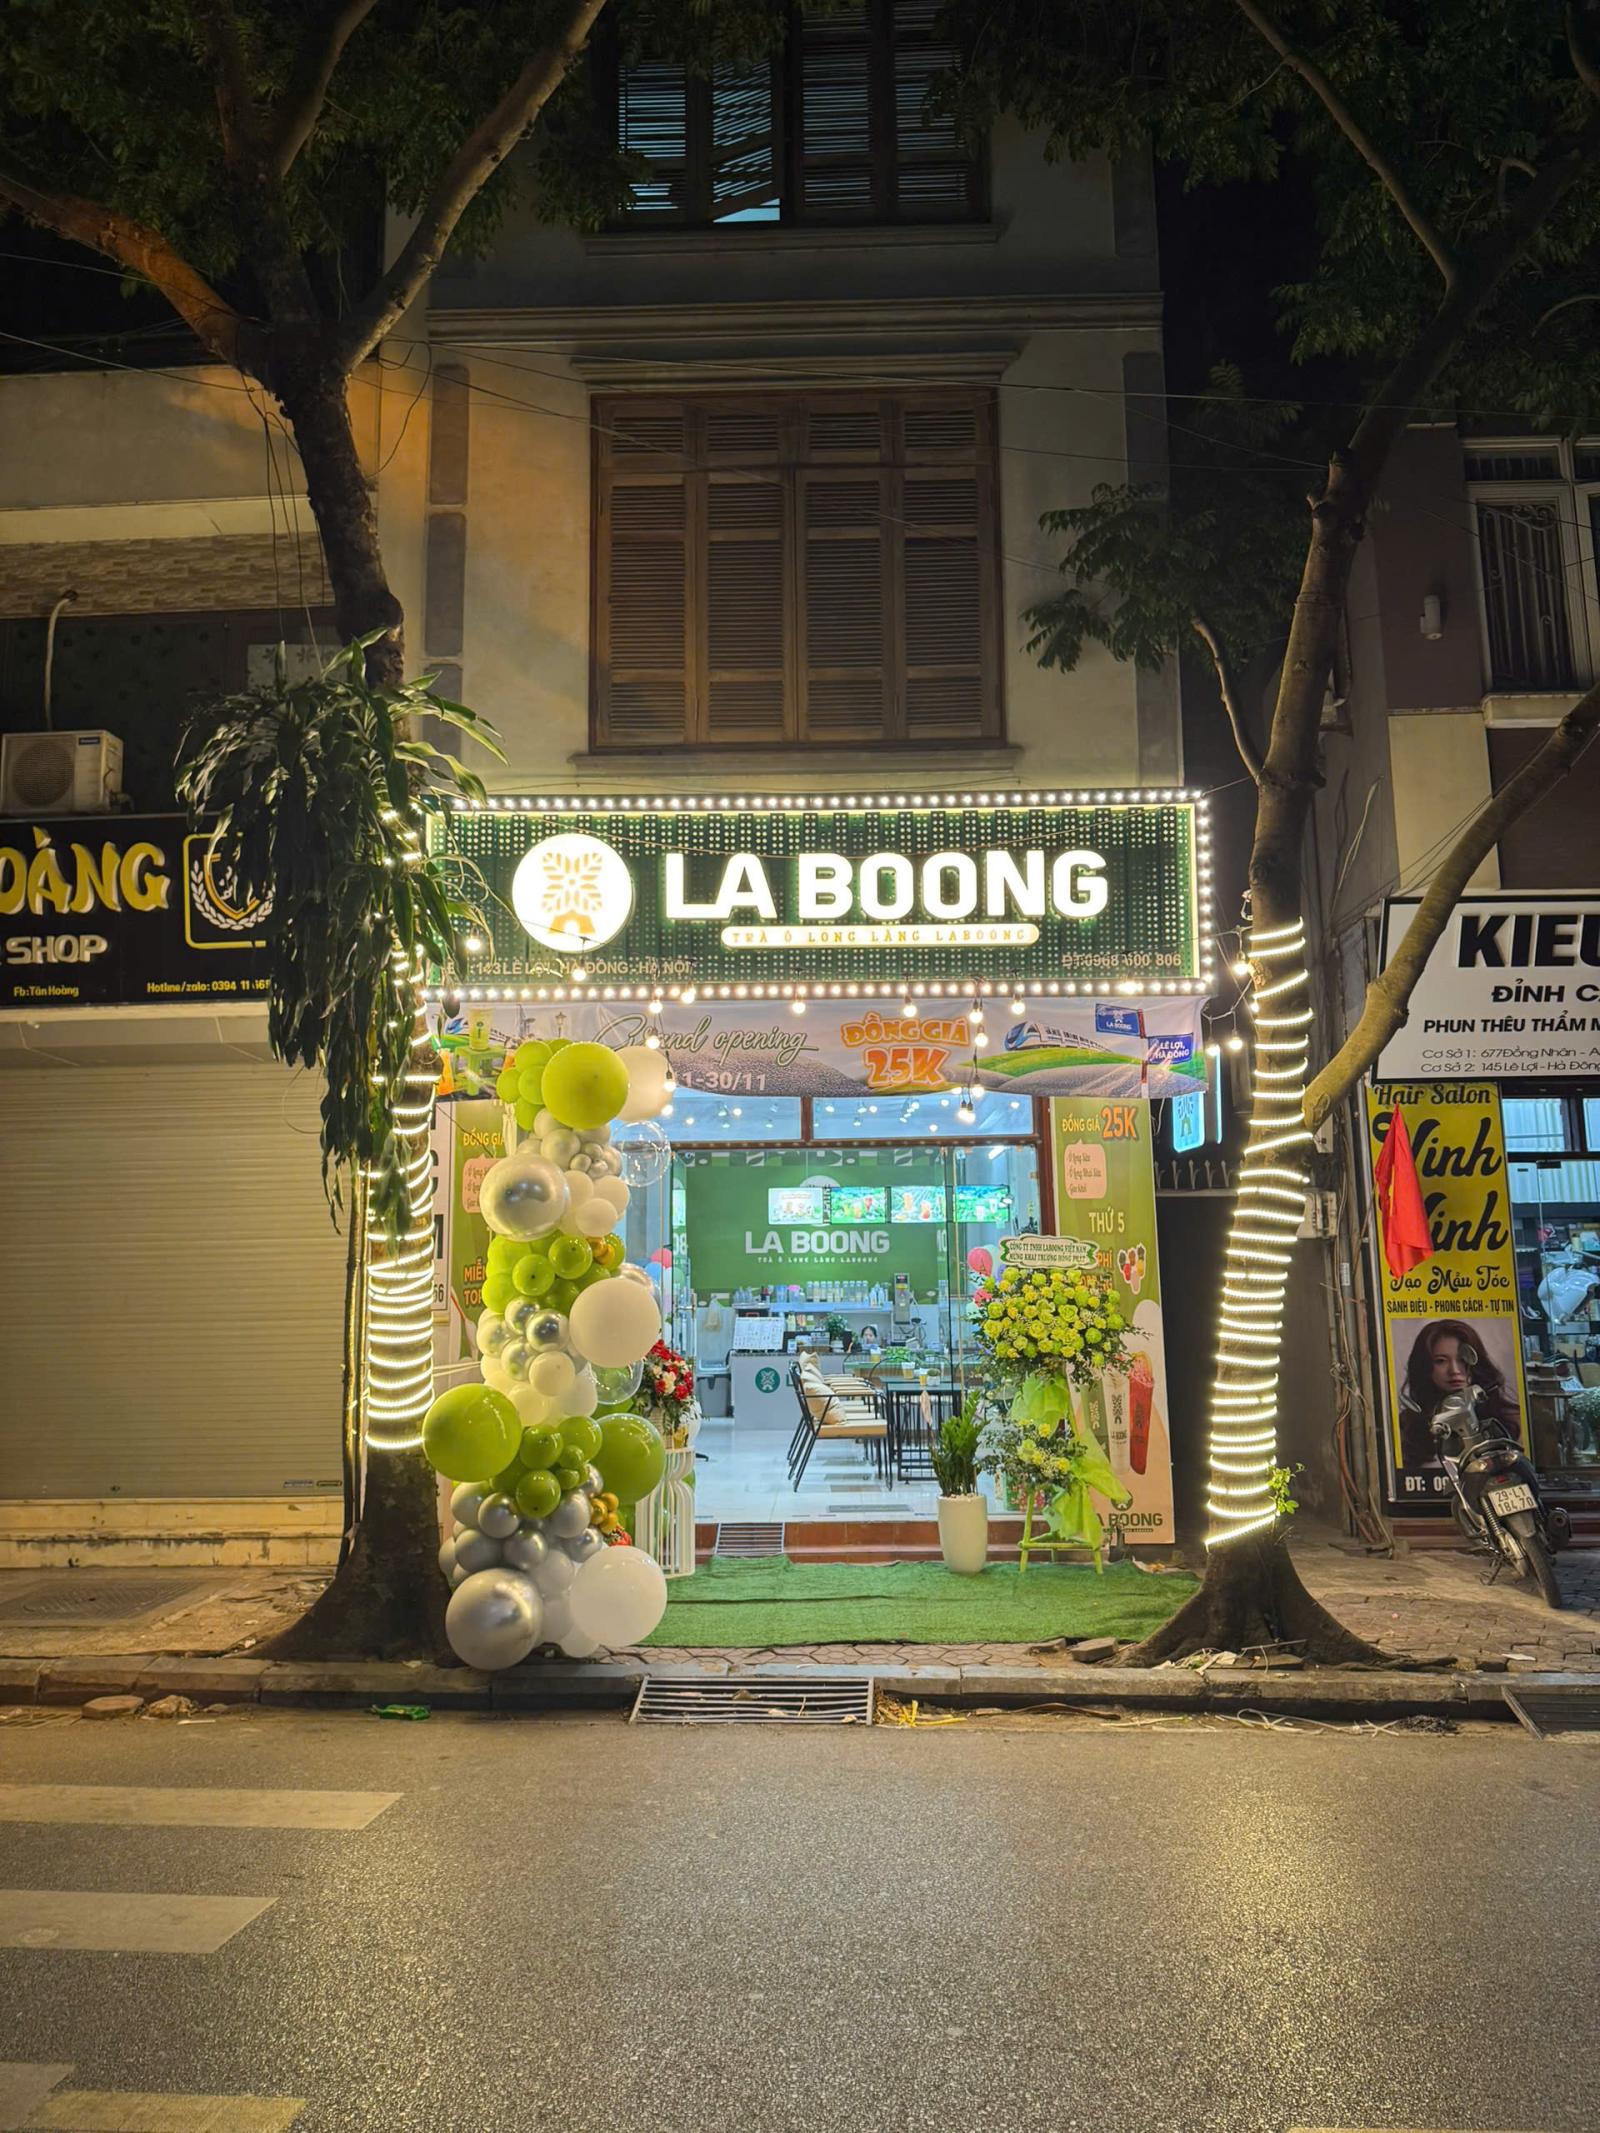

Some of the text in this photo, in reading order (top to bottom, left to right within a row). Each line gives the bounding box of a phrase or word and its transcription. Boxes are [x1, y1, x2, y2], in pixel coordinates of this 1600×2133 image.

[666, 850, 1108, 919] LA BOONG
[808, 931, 856, 943] LONG
[936, 930, 1025, 942] LABOONG
[6, 935, 108, 965] SHOP
[1156, 953, 1182, 967] 806
[586, 959, 629, 975] ĐÔNG
[212, 980, 237, 992] 0394
[1491, 978, 1566, 1002] ĐỈNH
[1423, 1019, 1475, 1033] PHUN
[1481, 1015, 1526, 1033] THÊU
[1532, 1010, 1587, 1032] THẨM
[714, 1026, 819, 1067] opening
[1541, 1047, 1576, 1058] Nhân
[864, 1047, 949, 1088] 25K
[1482, 1061, 1502, 1072] 145
[1504, 1061, 1518, 1072] Lê
[1548, 1060, 1566, 1071] Hà
[1374, 1084, 1491, 1105] Hair Salon
[1101, 1106, 1138, 1140] 25K
[1089, 1206, 1125, 1233] THỨ 5
[746, 1230, 890, 1254] LA BOONG
[1476, 1265, 1510, 1291] Tóc
[1387, 1298, 1408, 1313] SÀNH
[1435, 1299, 1460, 1313] PHONG
[1463, 1297, 1483, 1313] CÁCH
[1502, 1299, 1514, 1313] TIN
[1405, 1476, 1426, 1491] ĐT:
[1108, 1512, 1163, 1527] BOONG
